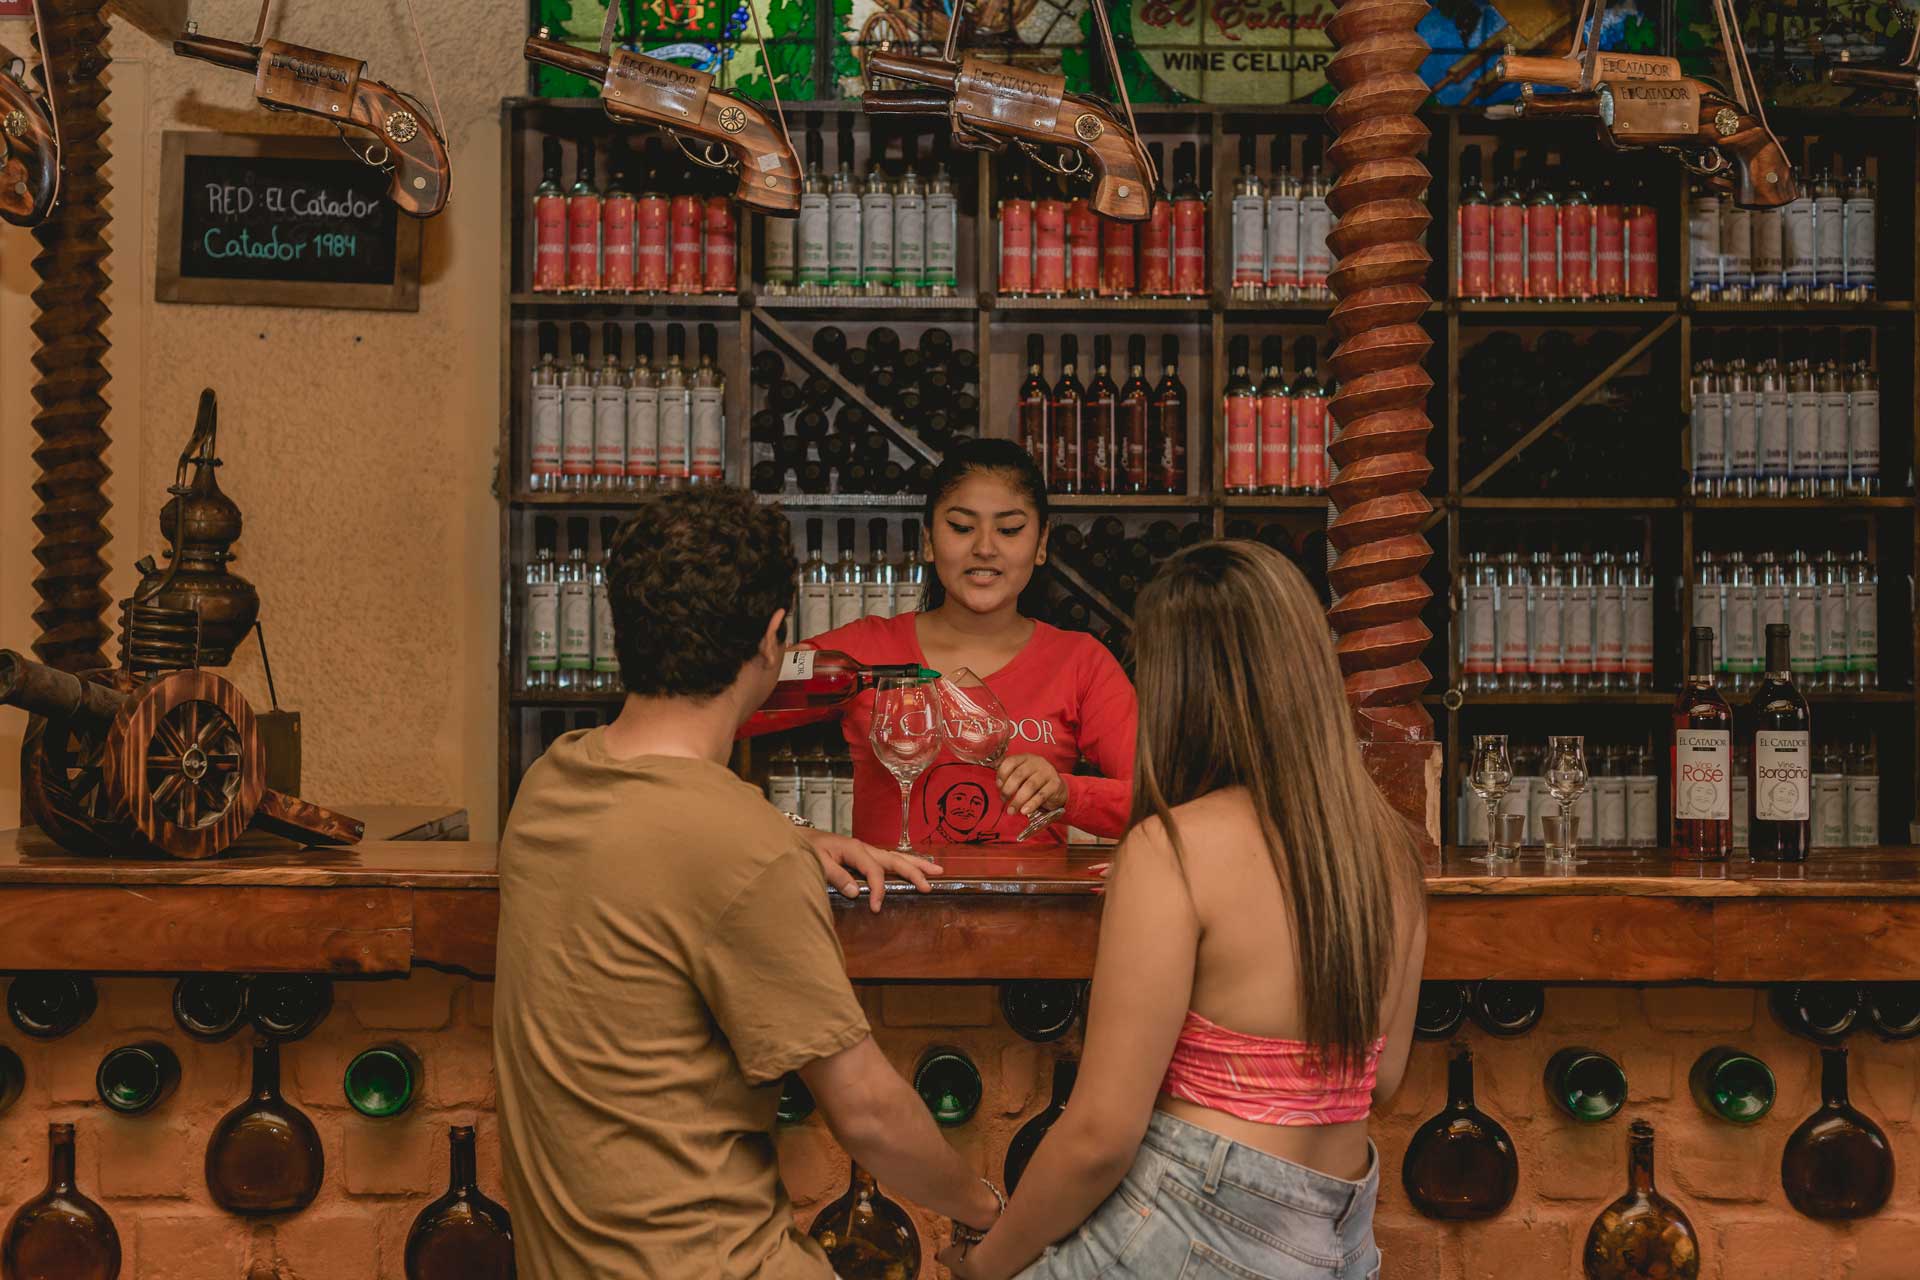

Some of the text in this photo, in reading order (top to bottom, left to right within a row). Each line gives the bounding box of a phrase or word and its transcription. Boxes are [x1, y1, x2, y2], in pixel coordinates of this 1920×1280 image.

[1163, 52, 1329, 72] WINE CELLAR
[1616, 59, 1671, 77] CATADOR
[991, 71, 1049, 97] CATADOR
[1635, 86, 1690, 100] CATADOR
[290, 188, 379, 218] Catador
[204, 225, 356, 260] Catador 1984
[1689, 736, 1727, 747] CATADOR
[1682, 763, 1724, 783] Rosé
[1776, 761, 1796, 769] Vino
